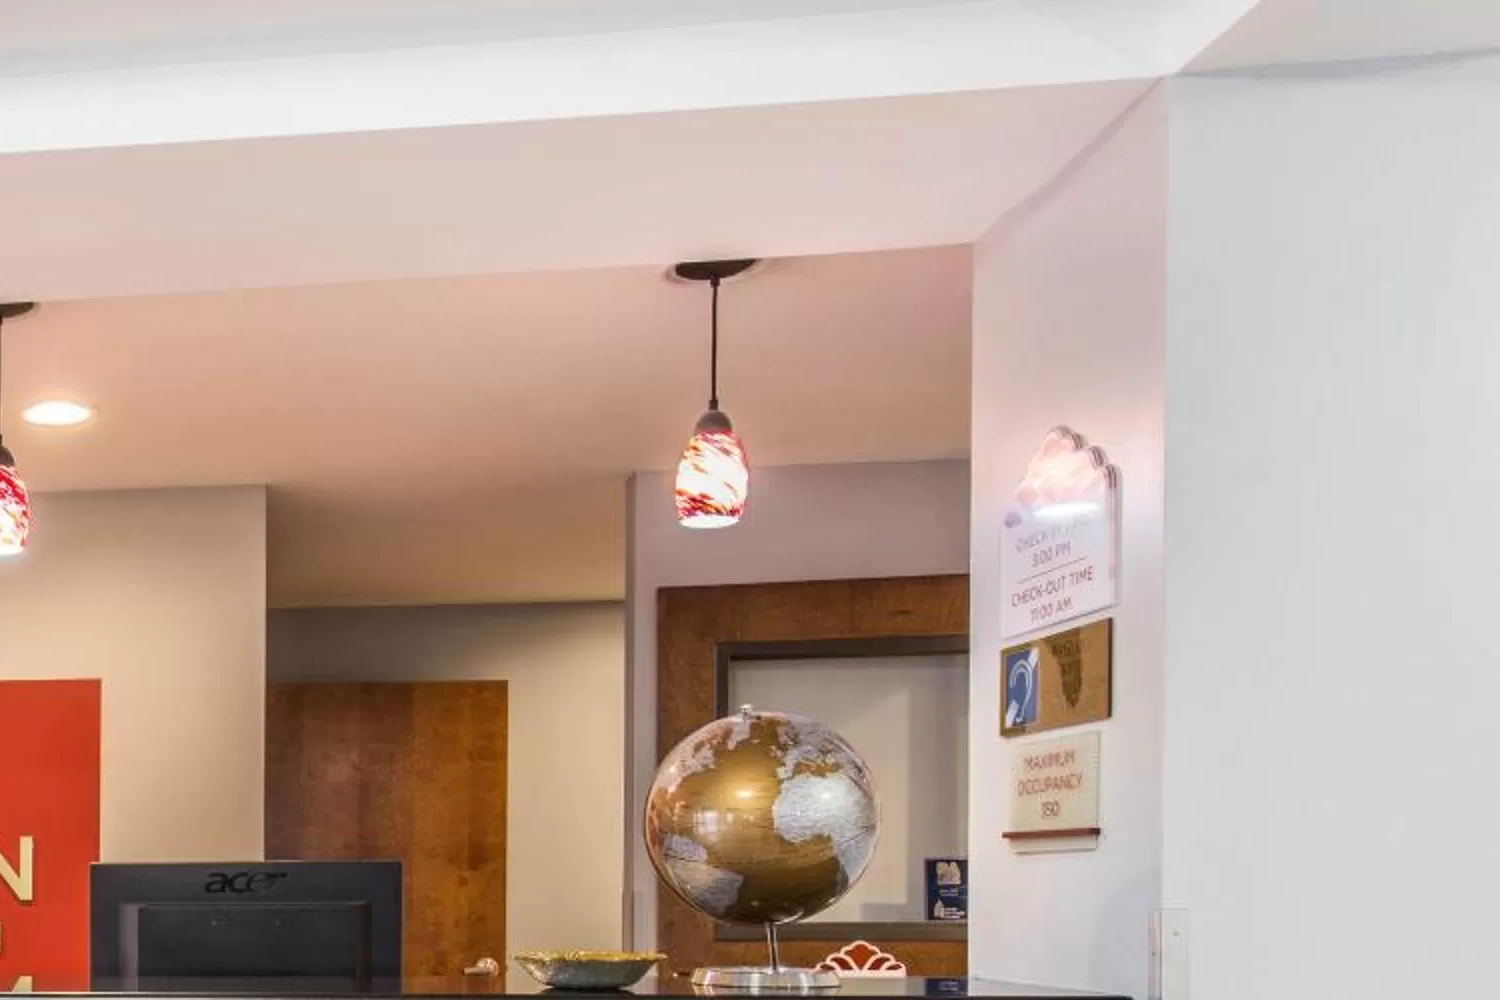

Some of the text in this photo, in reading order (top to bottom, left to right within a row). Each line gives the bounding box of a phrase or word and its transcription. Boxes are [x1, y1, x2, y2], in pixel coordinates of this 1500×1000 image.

[1011, 565, 1093, 608] CHECK-OUT TIME
[1054, 598, 1072, 612] AM
[1023, 749, 1076, 771] MAXIMUM
[1017, 773, 1083, 797] OCCUPANCY
[204, 871, 288, 894] acer
